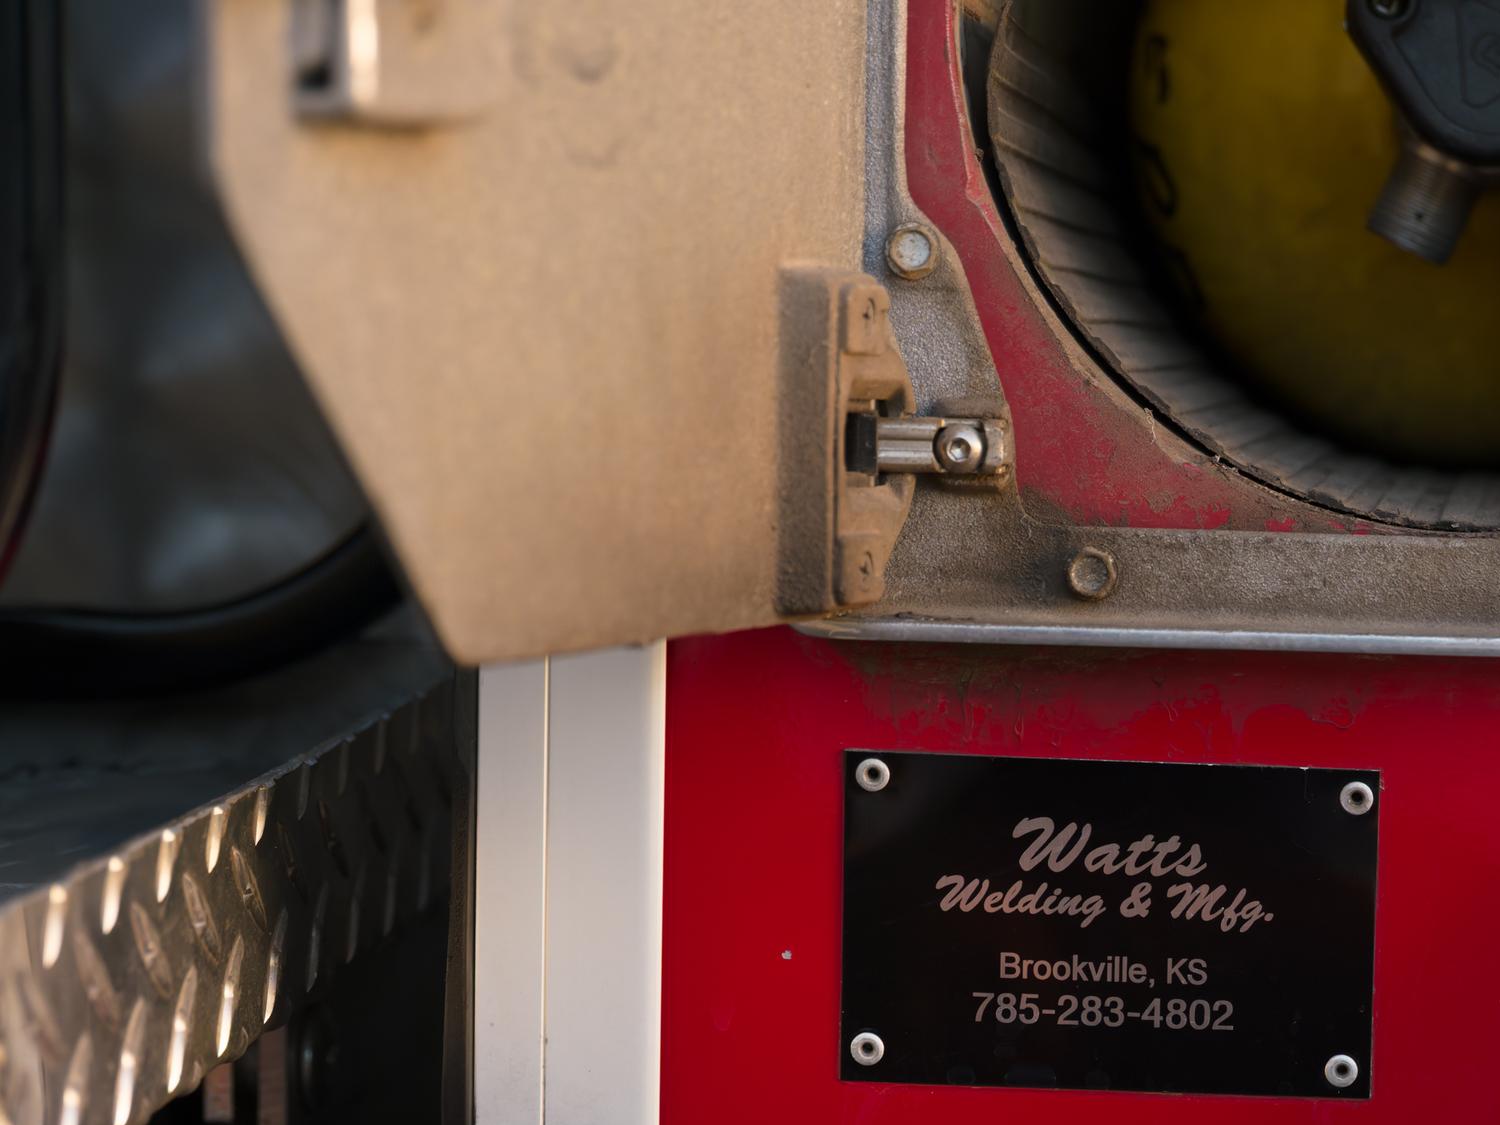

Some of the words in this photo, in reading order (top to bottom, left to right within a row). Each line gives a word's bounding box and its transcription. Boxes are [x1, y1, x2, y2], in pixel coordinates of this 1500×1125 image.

[1012, 817, 1207, 877] Watts
[936, 874, 1106, 928] Welding
[1120, 882, 1150, 918] &
[1167, 882, 1274, 933] Mfg.
[999, 952, 1155, 988] Brookville,
[1167, 958, 1208, 985] KS
[973, 992, 1234, 1032] 785-283-4802
